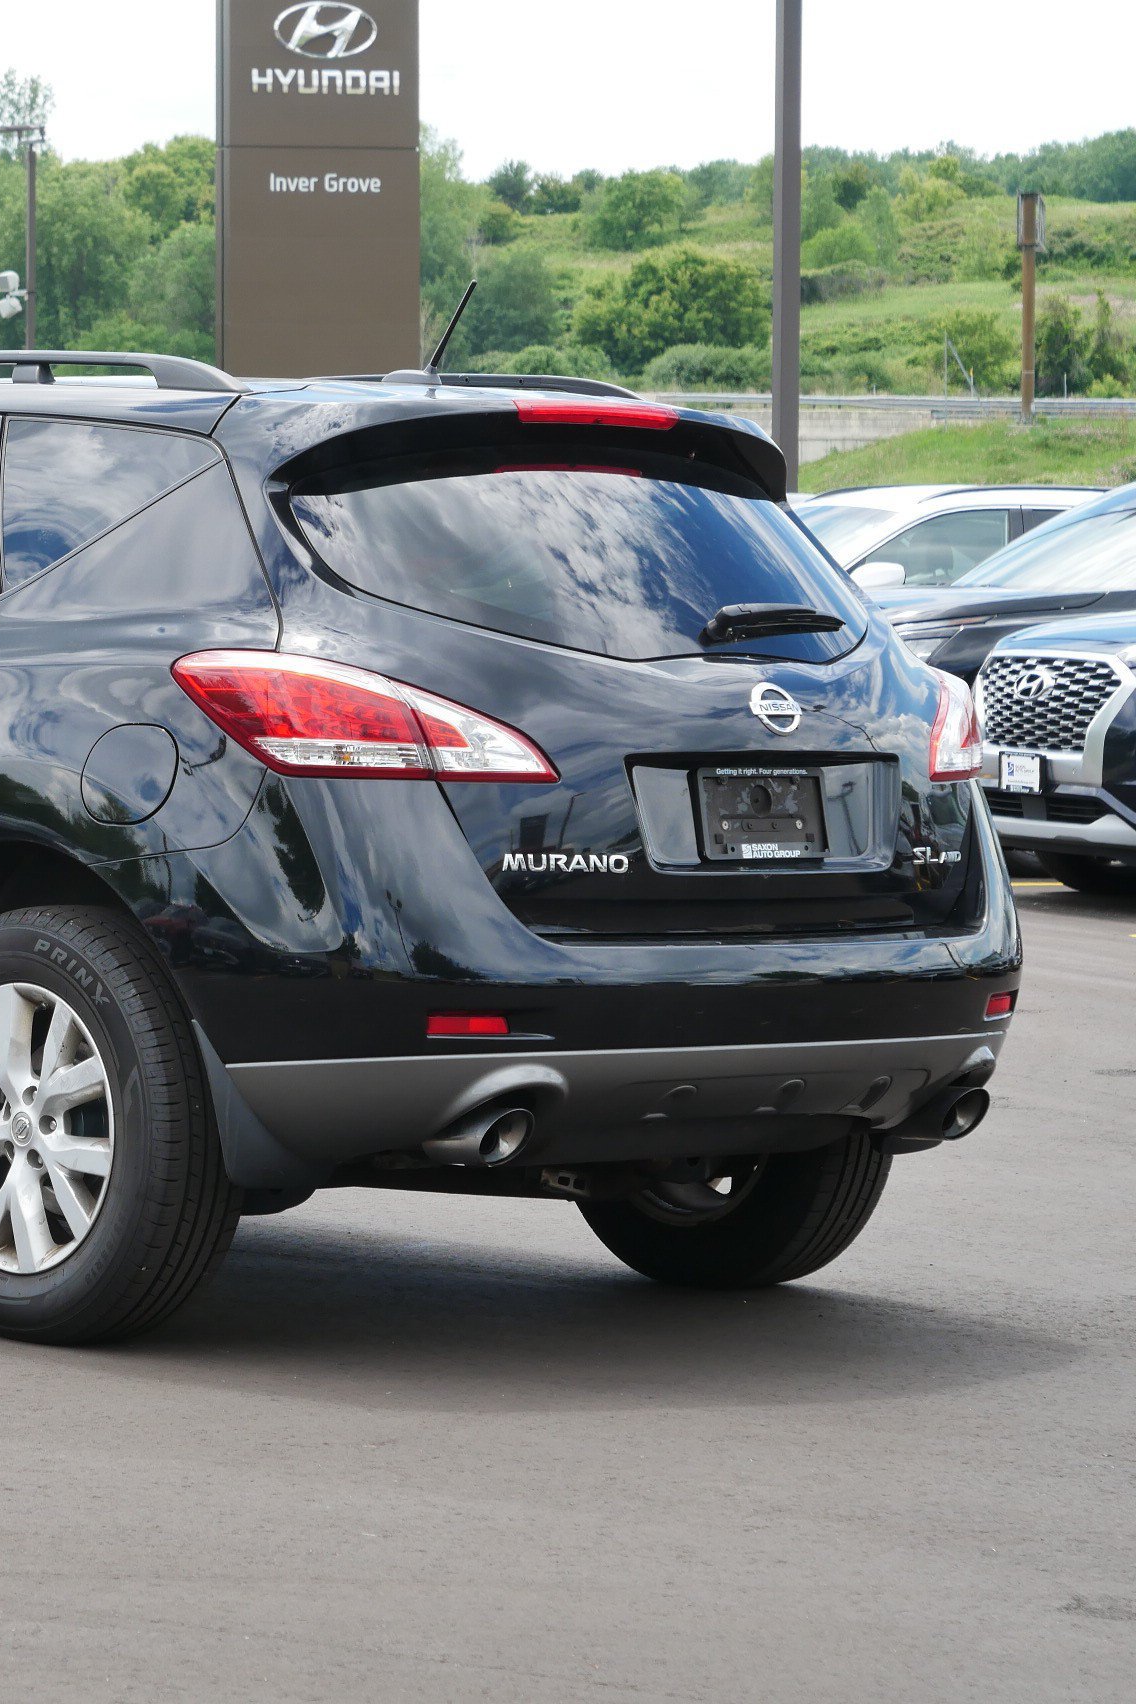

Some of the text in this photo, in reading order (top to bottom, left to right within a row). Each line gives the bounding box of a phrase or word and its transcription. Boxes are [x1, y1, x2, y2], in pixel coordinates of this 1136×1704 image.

[251, 67, 400, 96] HYUNDAI
[269, 172, 381, 193] Inver Grove
[759, 703, 799, 712] NISSAN
[716, 768, 737, 776] Getting
[743, 768, 758, 776] right.
[773, 768, 808, 776] generations.
[751, 843, 779, 851] SAXON
[752, 850, 801, 859] AUTO GROUP
[913, 846, 939, 865] SL
[502, 853, 629, 874] MURANO
[33, 938, 111, 1006] PRINX
